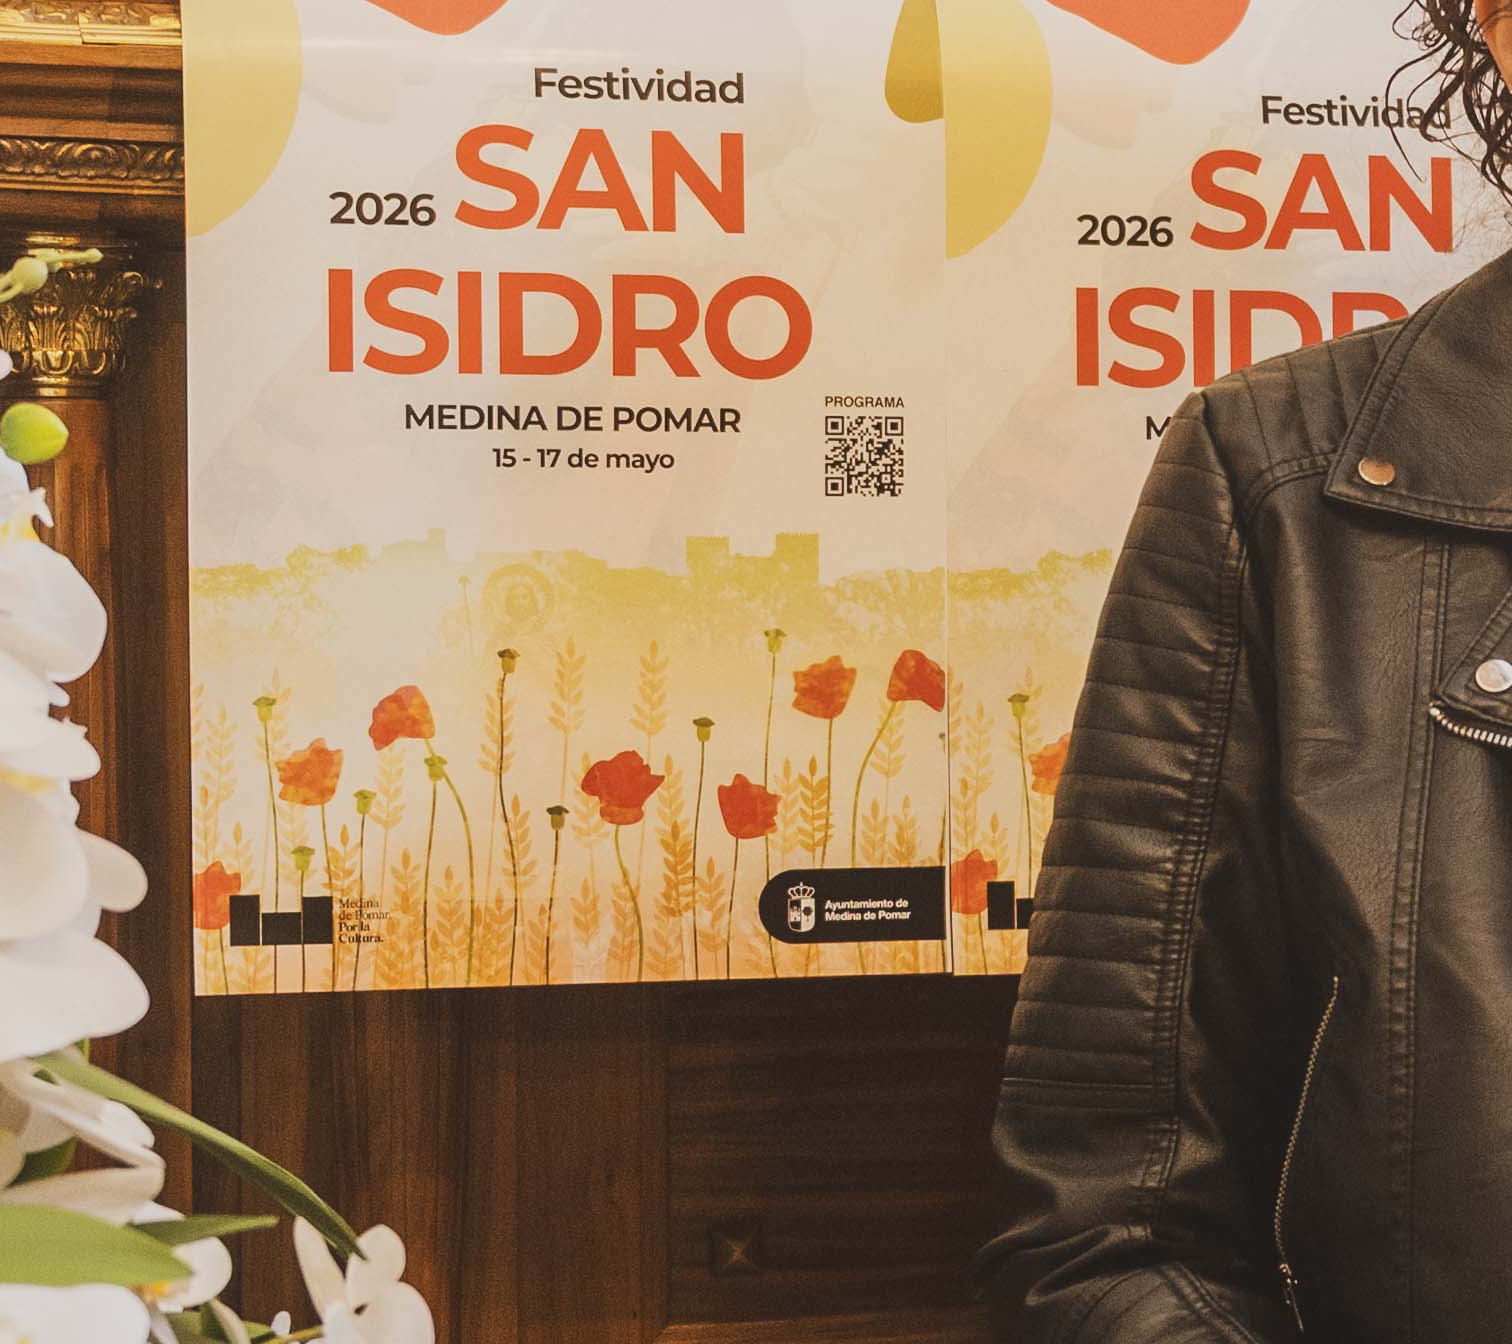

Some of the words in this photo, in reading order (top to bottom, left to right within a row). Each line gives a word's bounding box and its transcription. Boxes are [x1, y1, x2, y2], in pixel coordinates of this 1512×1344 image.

[534, 67, 744, 103] Festividad
[1261, 95, 1451, 129] Festividad
[329, 191, 436, 226] 2026
[455, 124, 745, 233] SAN
[1077, 214, 1174, 247] 2026
[1190, 149, 1453, 253] SAN
[328, 268, 812, 379] ISIDRO
[825, 396, 904, 408] PROGRAMA
[405, 404, 548, 432] MEDINA
[557, 406, 603, 432] DE
[613, 407, 741, 433] POMAR
[493, 448, 518, 468] 15
[537, 449, 561, 468] 17
[568, 448, 600, 469] de
[607, 452, 675, 473] mayo
[339, 898, 379, 908] Medina
[825, 899, 893, 911] Ayuntamiento
[896, 898, 909, 908] de
[339, 910, 352, 920] de
[825, 911, 862, 921] Medina
[863, 911, 877, 920] de
[879, 910, 911, 920] Pomar
[339, 922, 357, 932] Por
[360, 921, 370, 931] la
[339, 933, 384, 944] Cultura.
